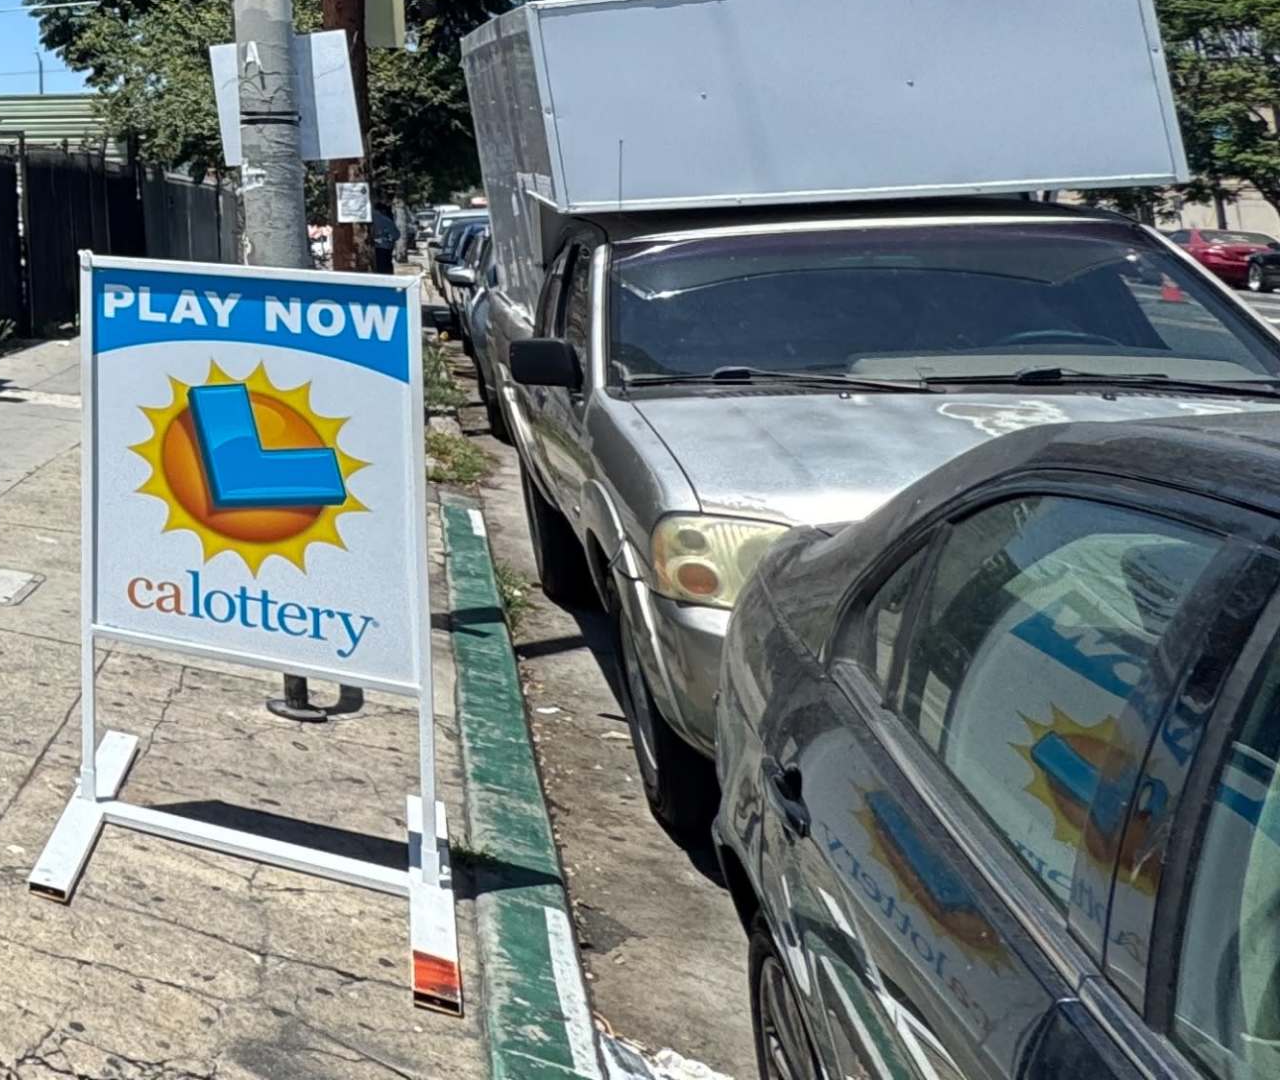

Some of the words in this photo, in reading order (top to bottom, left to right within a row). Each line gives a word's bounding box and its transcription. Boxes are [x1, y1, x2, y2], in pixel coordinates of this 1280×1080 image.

[103, 283, 243, 328] PLAY
[264, 294, 400, 342] NOW
[127, 570, 374, 658] calottery
